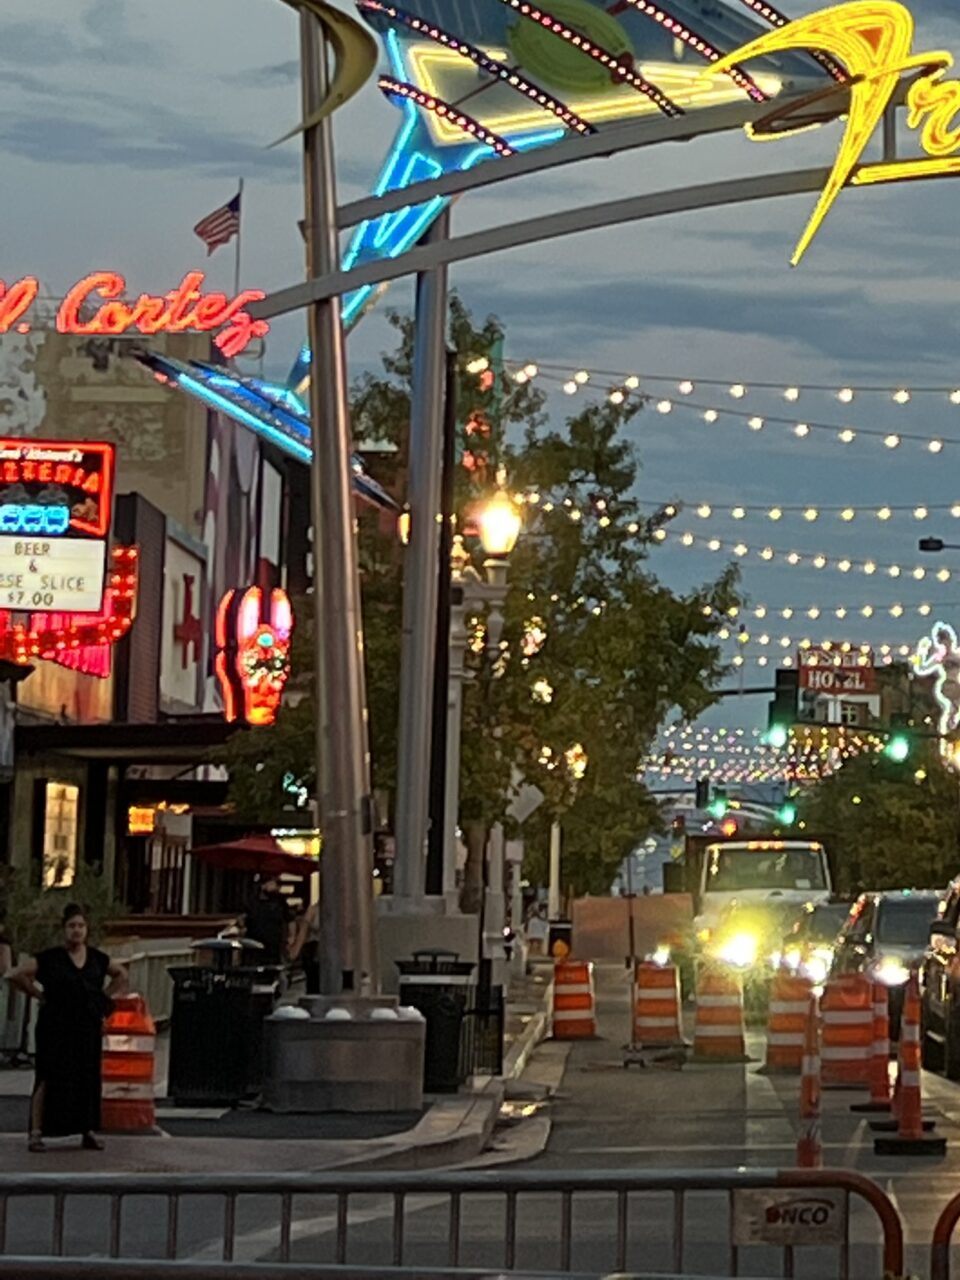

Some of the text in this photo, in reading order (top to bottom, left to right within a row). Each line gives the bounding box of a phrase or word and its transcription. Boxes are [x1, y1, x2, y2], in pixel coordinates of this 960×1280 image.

[55, 271, 270, 358] Cortez
[0, 461, 100, 493] ZZERIA
[14, 542, 51, 556] BEER
[28, 560, 38, 573] &
[40, 577, 86, 592] SLICE
